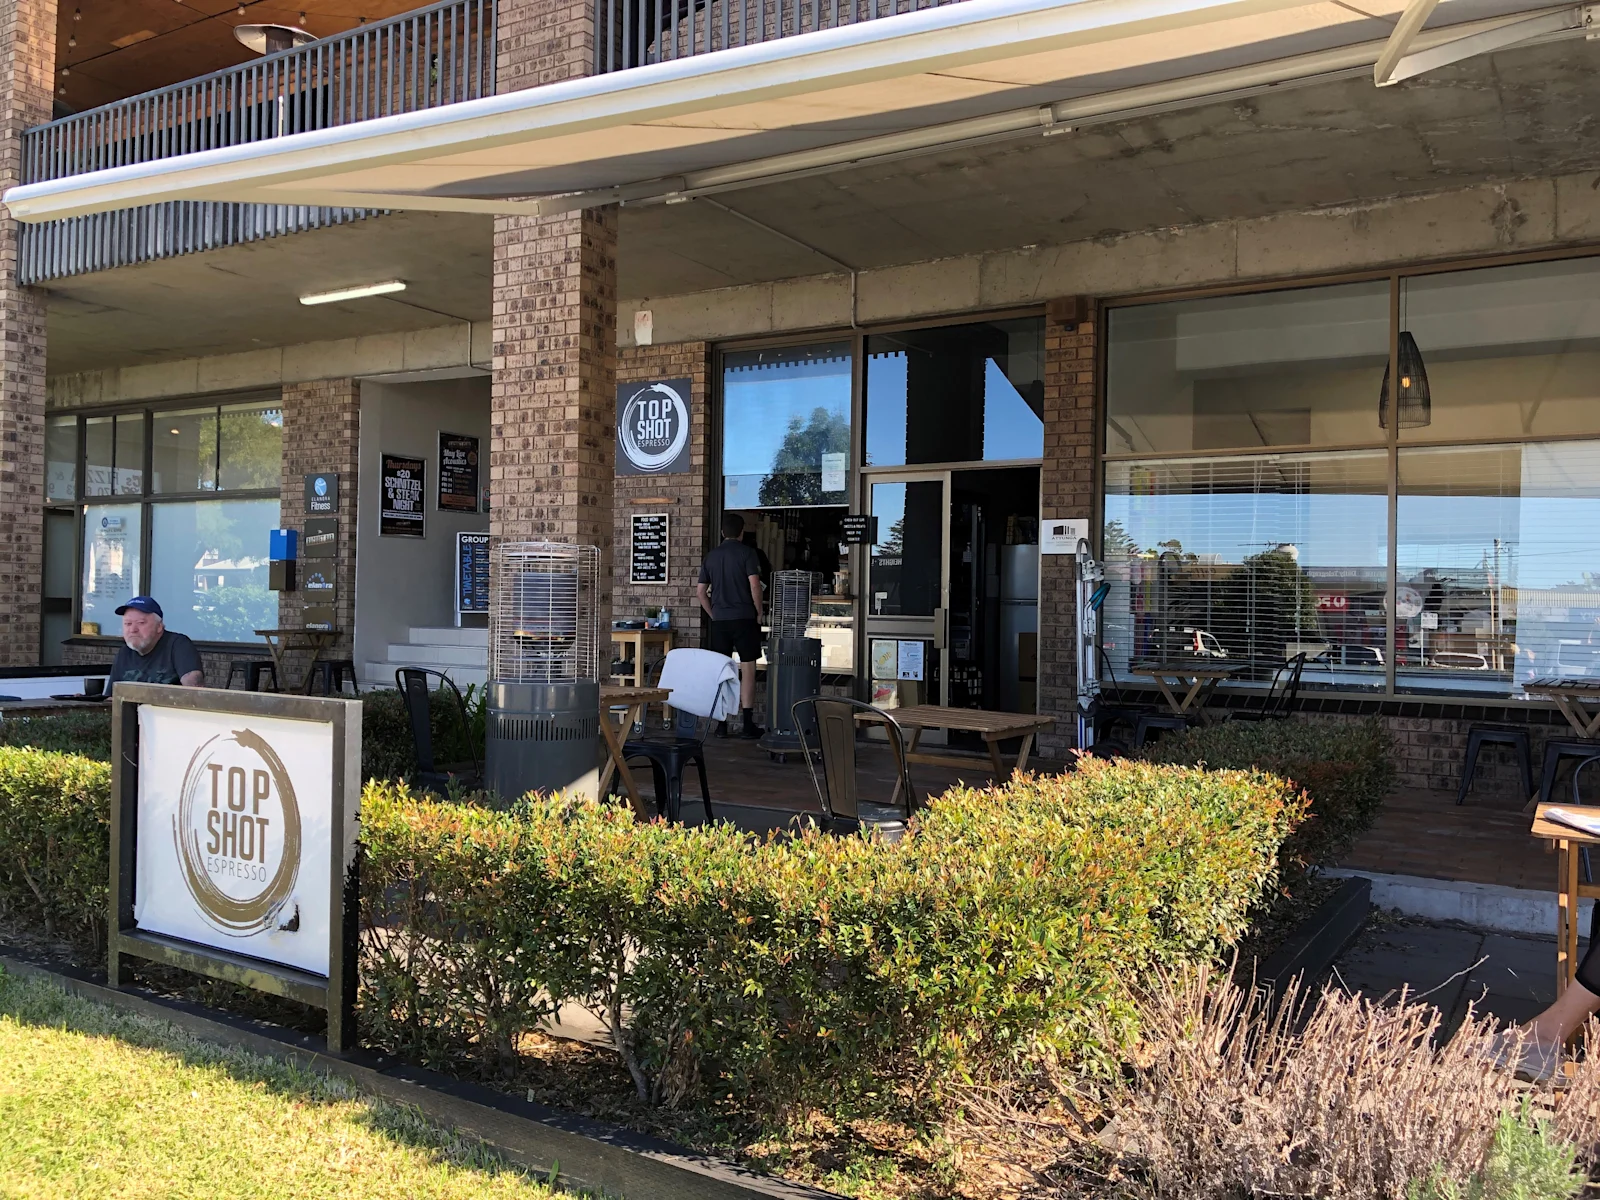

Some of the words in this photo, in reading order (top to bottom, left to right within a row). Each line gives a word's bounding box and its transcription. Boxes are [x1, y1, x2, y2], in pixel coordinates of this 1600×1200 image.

[638, 399, 672, 420] TOP
[637, 419, 672, 440] SHOT
[638, 439, 670, 447] ESPRESSO
[386, 460, 421, 472] Thursdays
[397, 470, 410, 478] $20
[385, 476, 422, 491] SCHNITZEL
[388, 488, 394, 498] &
[396, 489, 419, 501] STEAK
[311, 502, 330, 510] Fitness
[393, 499, 414, 511] NIGHT
[463, 544, 472, 596] TIMETABLE
[207, 764, 270, 815] TOP
[207, 810, 269, 864] SHOT
[207, 856, 266, 883] ESPRESSO
